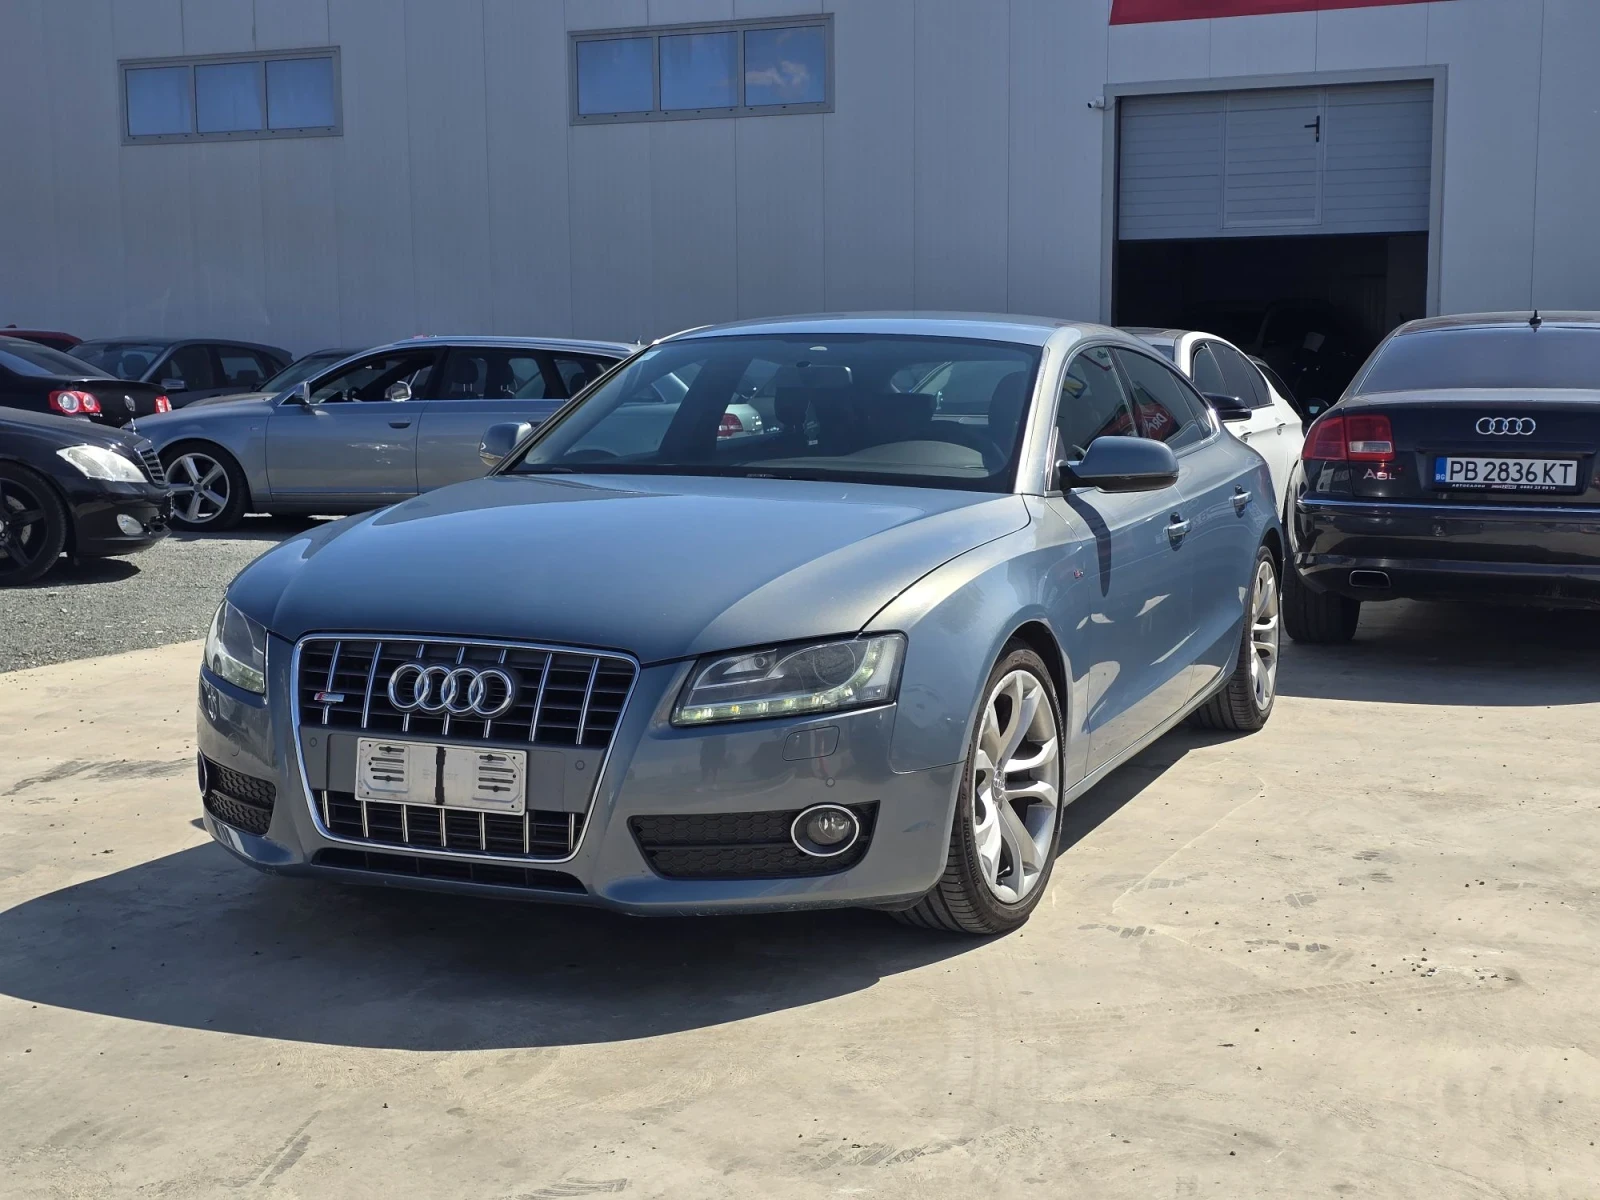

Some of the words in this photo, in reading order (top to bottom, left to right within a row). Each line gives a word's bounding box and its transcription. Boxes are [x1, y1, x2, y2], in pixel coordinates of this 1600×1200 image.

[1435, 473, 1446, 481] BG
[1449, 460, 1479, 481] PB
[1482, 461, 1538, 483] 2836
[1542, 462, 1573, 484] KT
